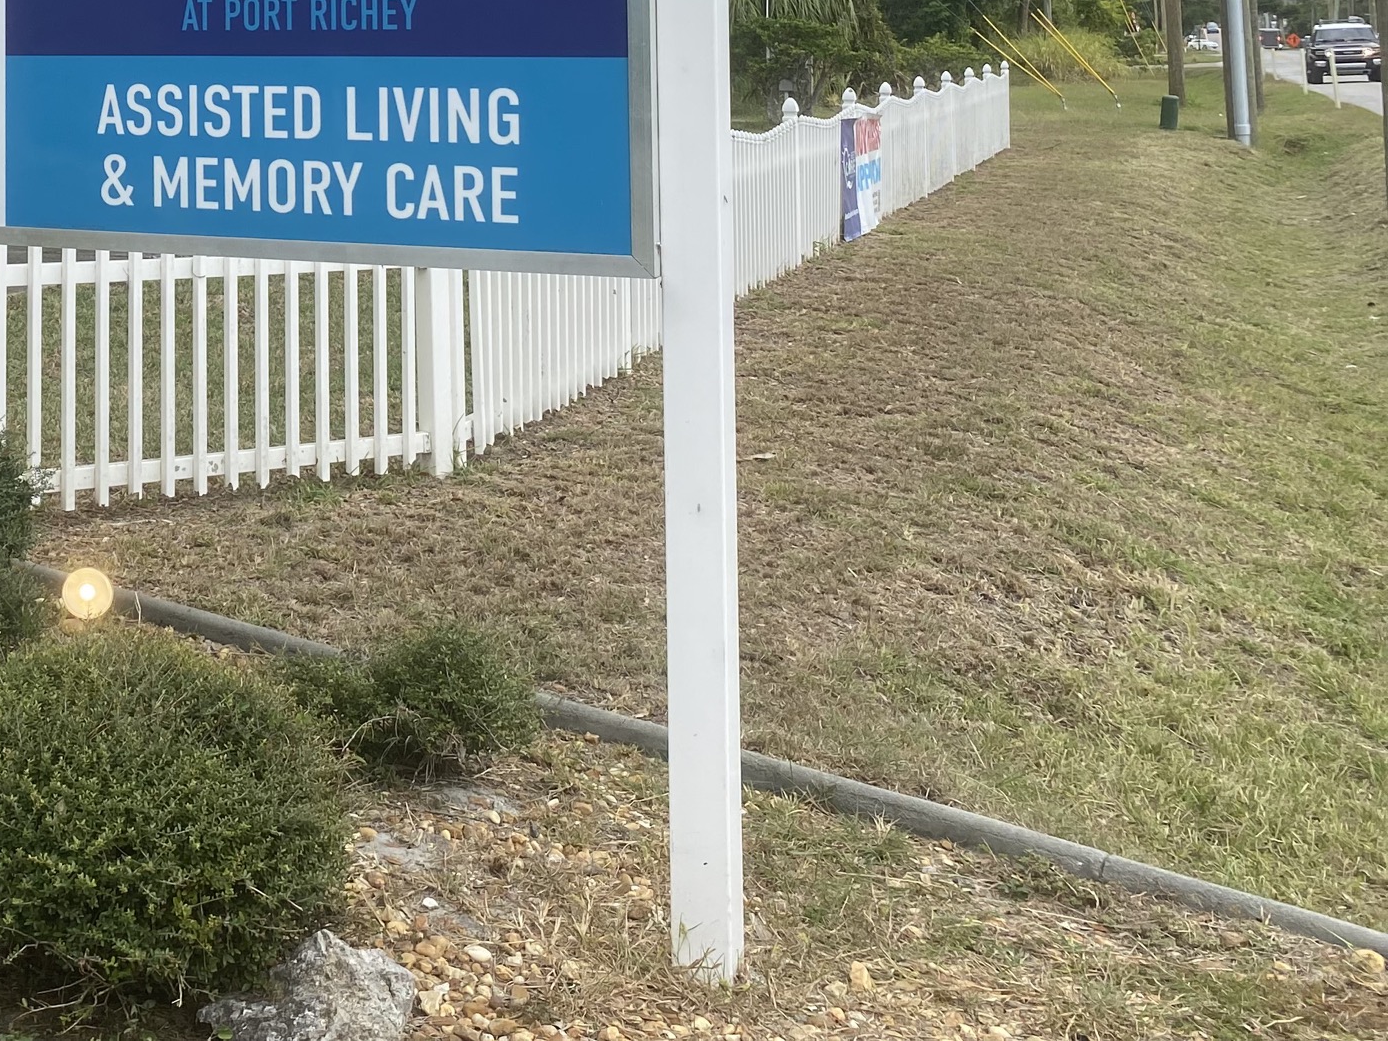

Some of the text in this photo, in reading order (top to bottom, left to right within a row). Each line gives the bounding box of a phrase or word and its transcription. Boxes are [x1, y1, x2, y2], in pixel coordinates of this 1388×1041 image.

[98, 84, 519, 145] ASSISTED LIVING
[101, 154, 518, 223] & MEMORY CARE
